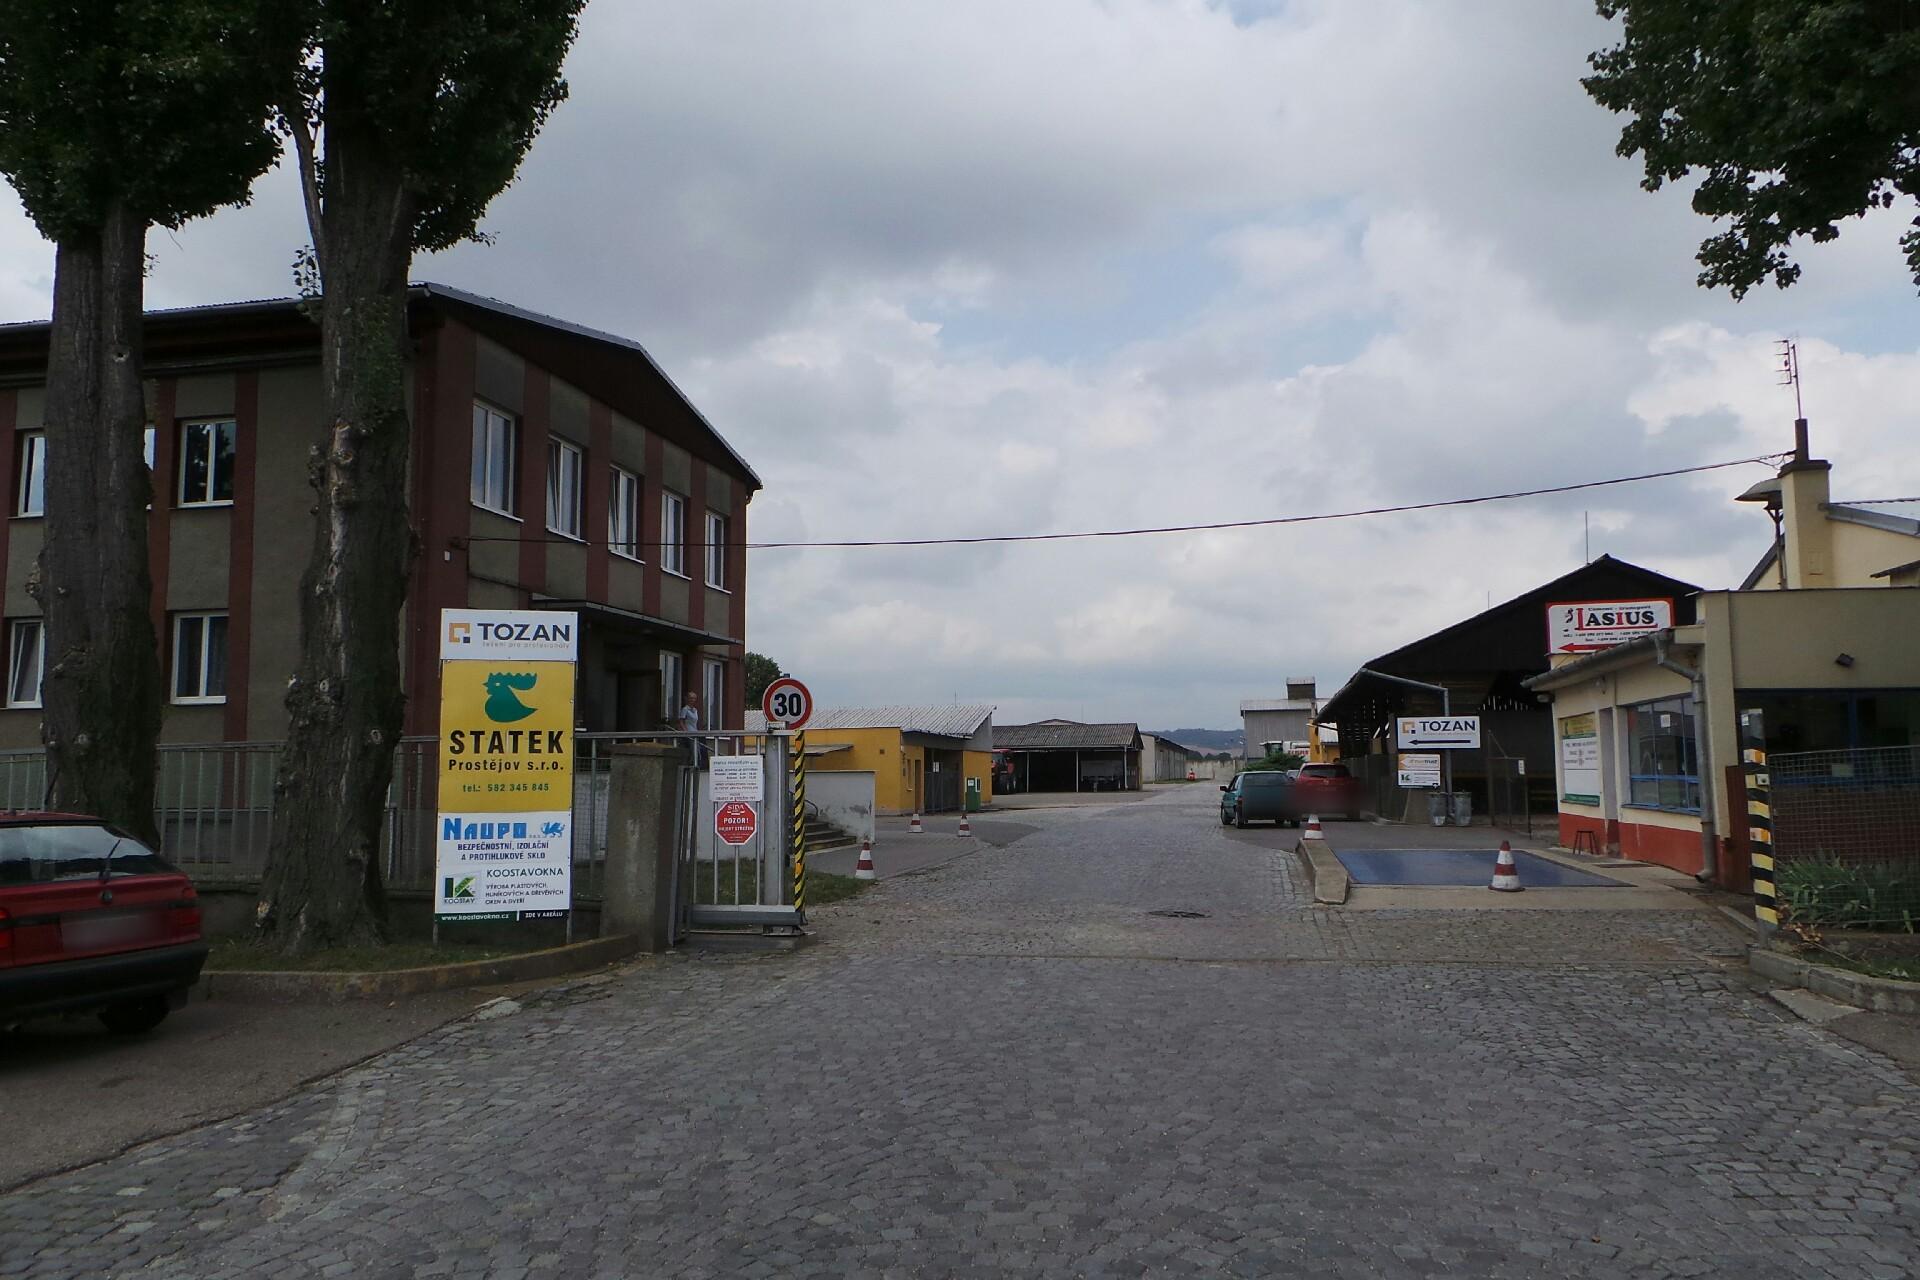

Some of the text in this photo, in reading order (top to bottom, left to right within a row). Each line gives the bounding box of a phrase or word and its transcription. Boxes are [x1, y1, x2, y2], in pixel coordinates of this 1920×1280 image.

[1574, 607, 1658, 630] LASIUS
[477, 622, 570, 642] TOZAN
[773, 693, 802, 717] 30
[1419, 720, 1476, 732] TOZAN
[449, 729, 564, 755] STATEK
[448, 758, 564, 773] Prostějov s.r.o.
[487, 783, 506, 792] 582
[509, 783, 528, 792] 345
[531, 783, 549, 791] 845
[461, 853, 467, 861] A
[527, 852, 546, 860] SKLO
[486, 867, 564, 878] KOOSTAVOKNA
